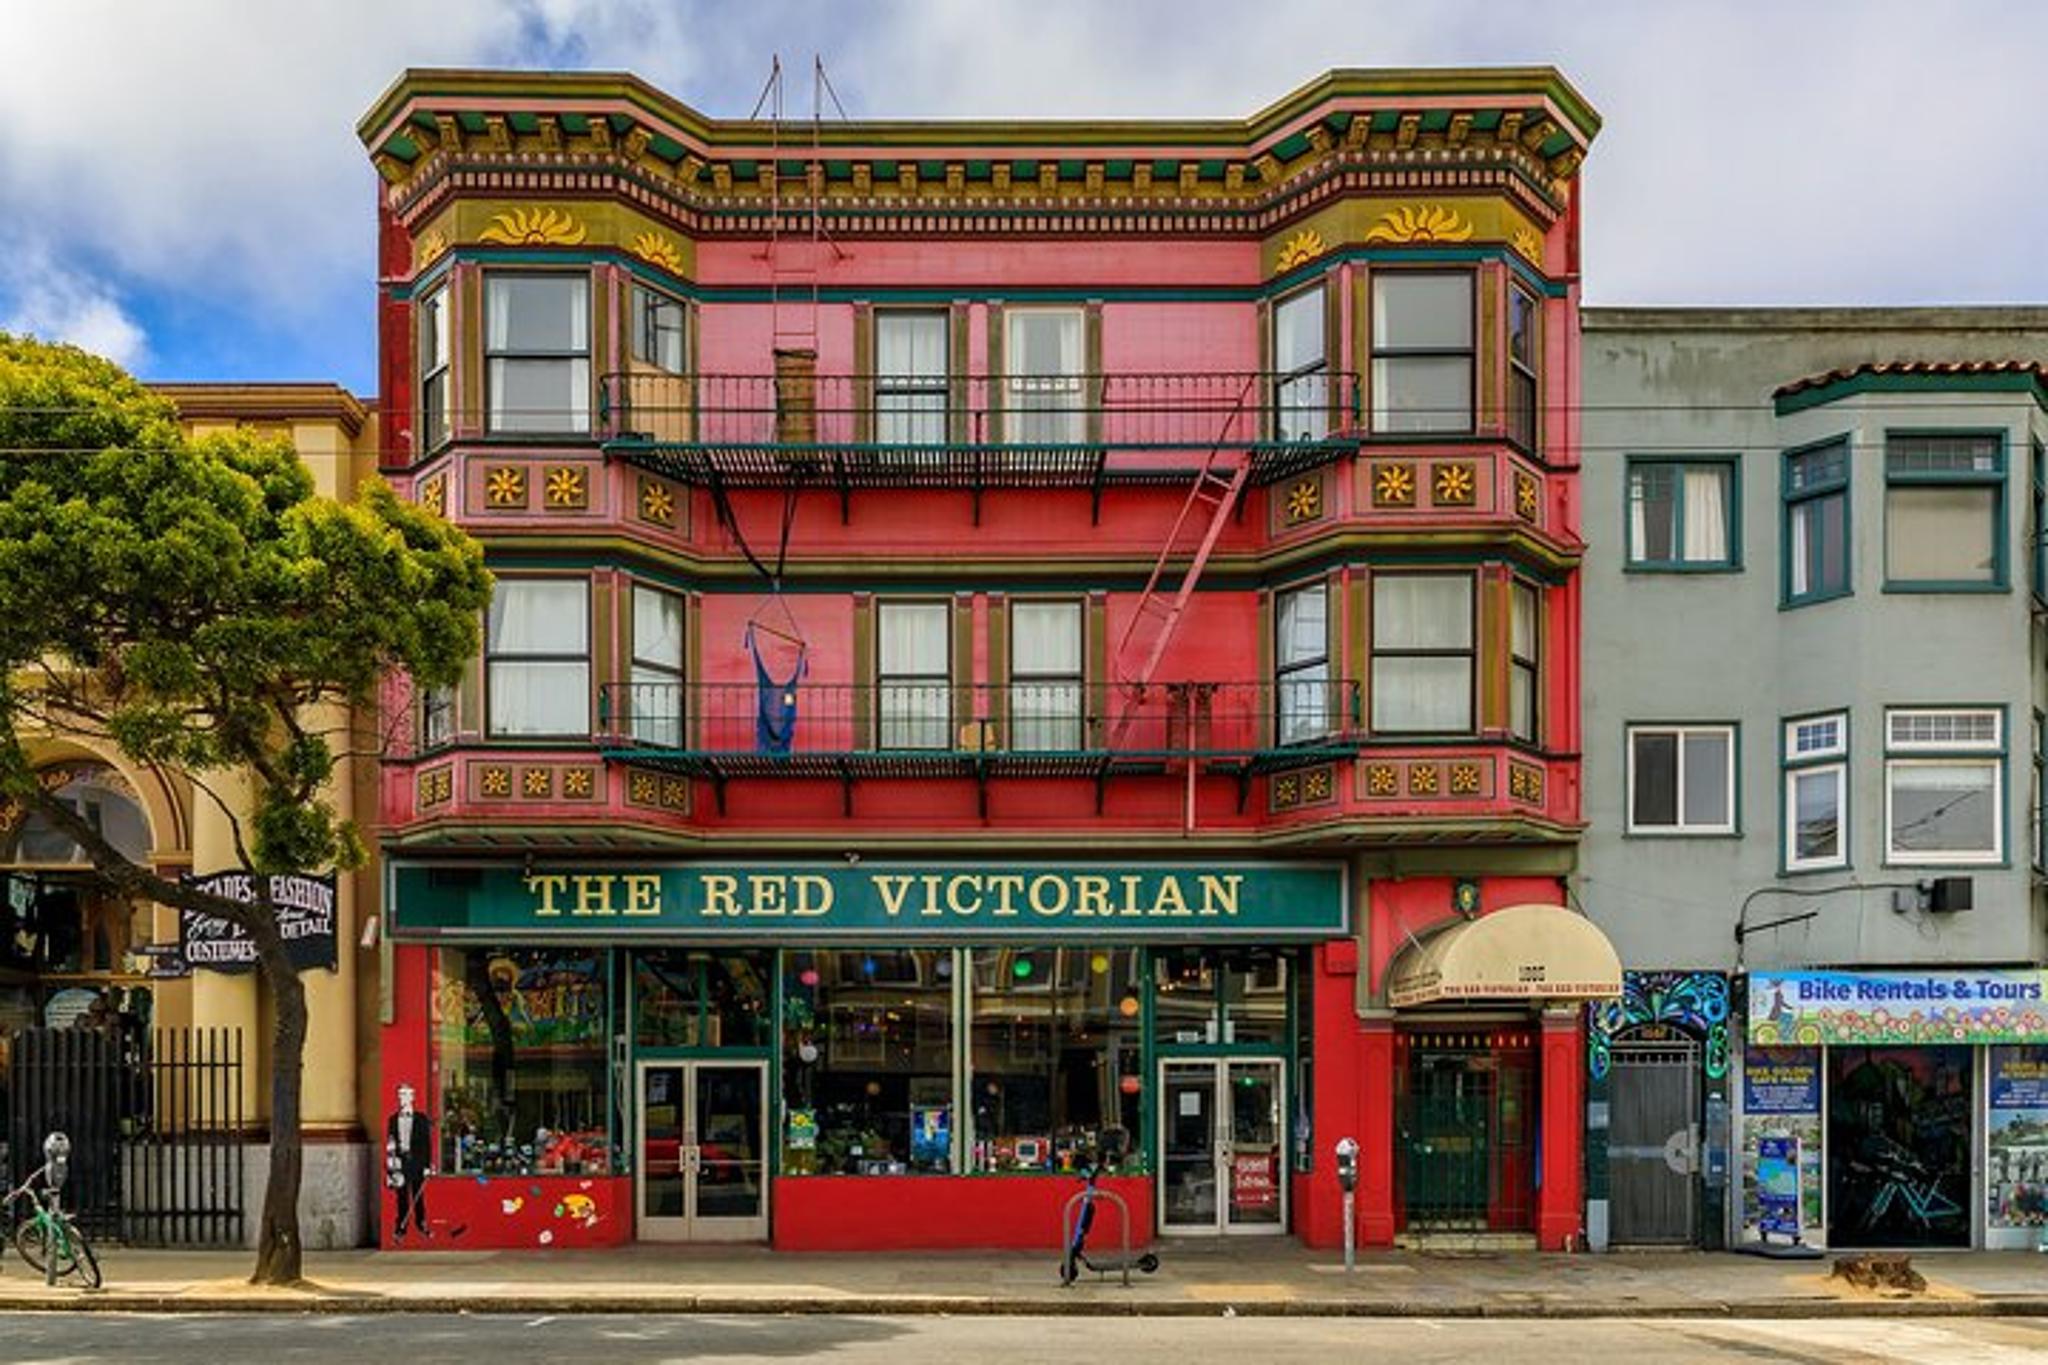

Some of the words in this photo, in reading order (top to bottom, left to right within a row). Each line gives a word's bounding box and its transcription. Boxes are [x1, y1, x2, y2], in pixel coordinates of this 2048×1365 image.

[529, 875, 662, 916] THE
[700, 875, 835, 916] RED
[872, 875, 1243, 916] VICTORIAN
[1799, 978, 1851, 1000] Bike
[1856, 978, 1948, 1000] Rentals
[1953, 980, 1973, 1000] &
[1975, 980, 2042, 1000] Tours
